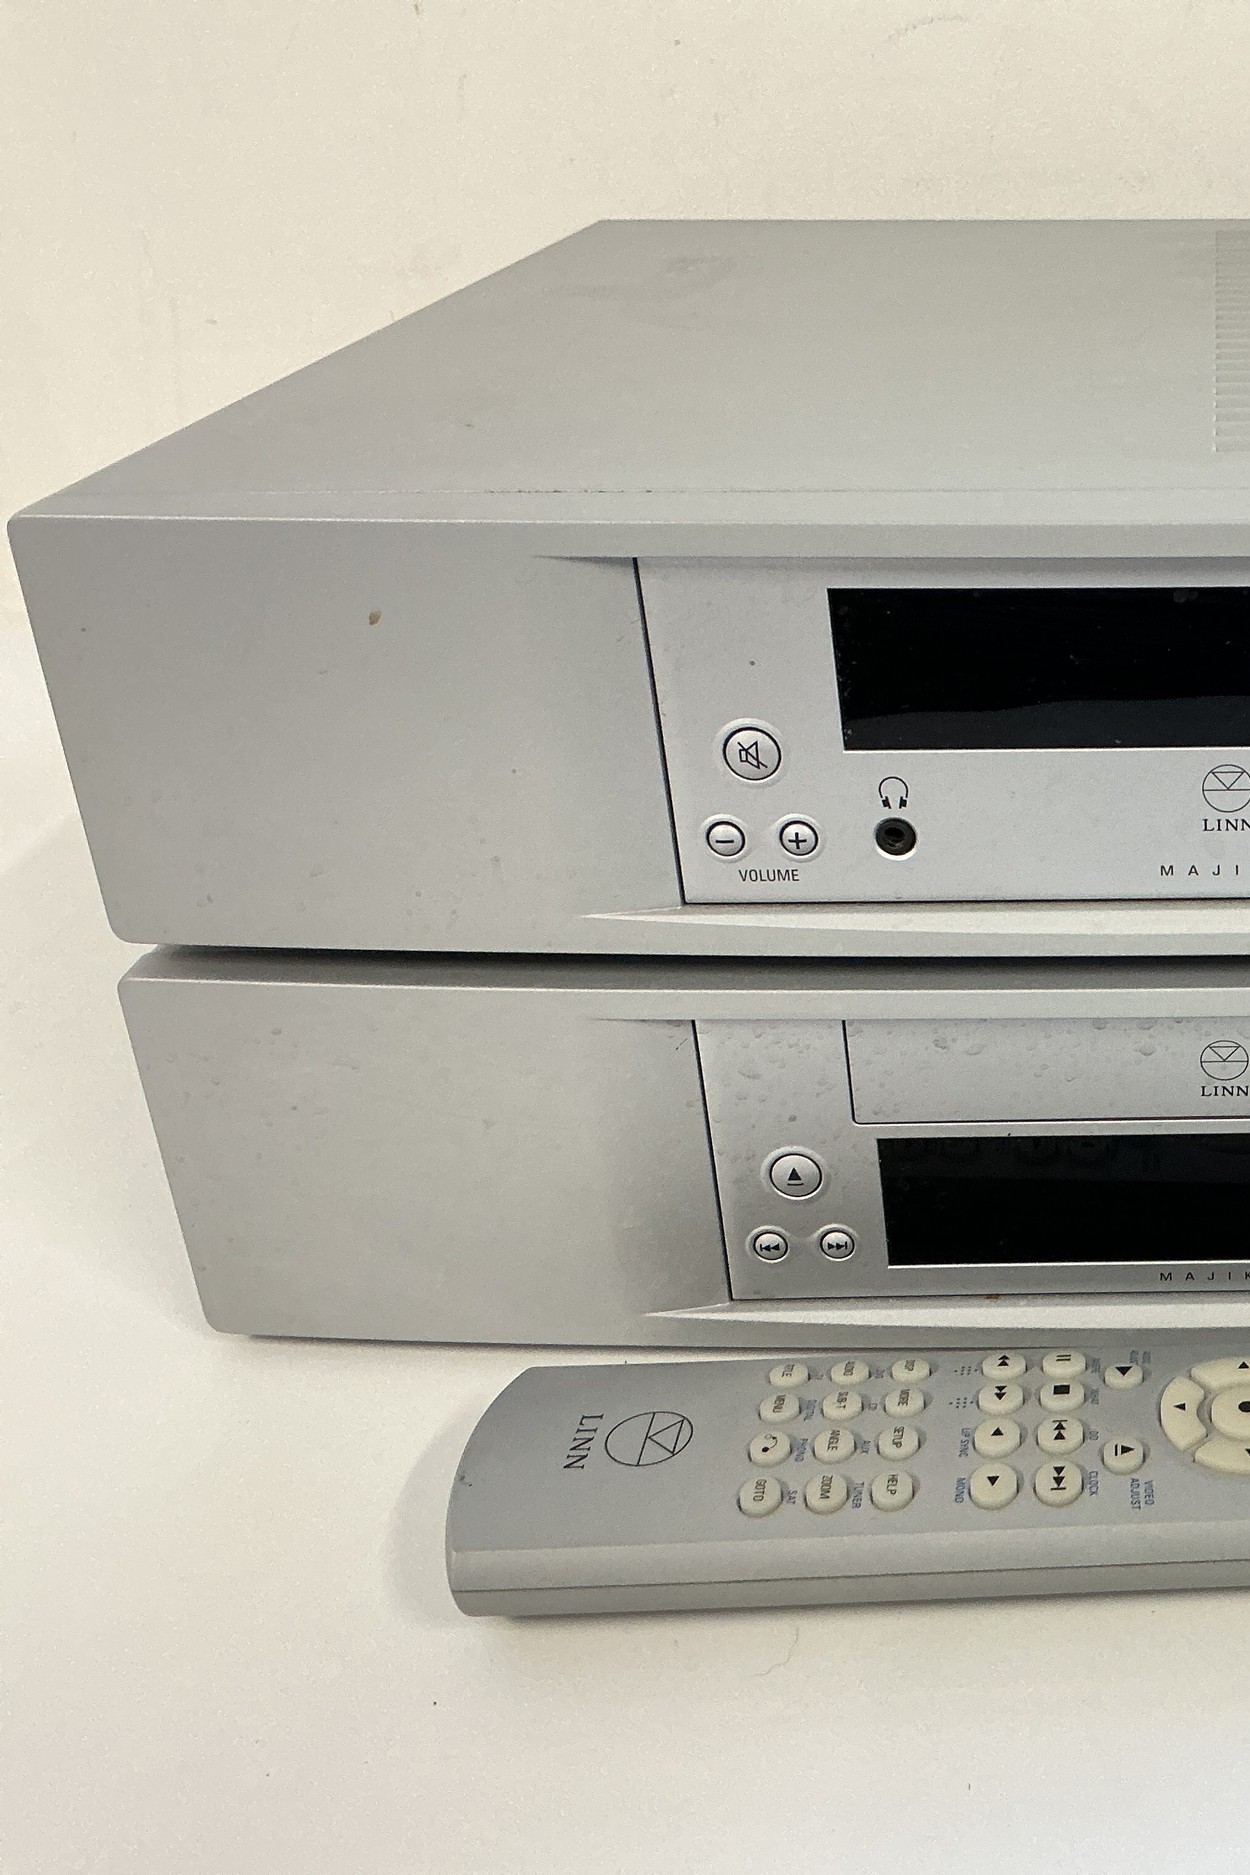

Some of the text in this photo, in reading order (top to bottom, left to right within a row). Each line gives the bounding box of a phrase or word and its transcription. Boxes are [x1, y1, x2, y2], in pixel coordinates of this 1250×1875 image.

[739, 868, 799, 882] VOLUME
[1201, 1085, 1249, 1097] LINN
[773, 1394, 786, 1413] MENU
[898, 1388, 911, 1407] MORE
[563, 1413, 604, 1469] LINN
[827, 1429, 841, 1451] ANGLE
[892, 1426, 905, 1448] SETUP
[753, 1479, 767, 1502] GOTO
[819, 1475, 833, 1499] ZOOM
[886, 1473, 899, 1496] HELP
[955, 1477, 966, 1504] MONO
[1088, 1470, 1099, 1497] CLOCK
[1130, 1478, 1141, 1510] ADJUST
[1144, 1479, 1155, 1506] VIDEO
[787, 1490, 798, 1505] SAT
[851, 1482, 864, 1509] TUNER
